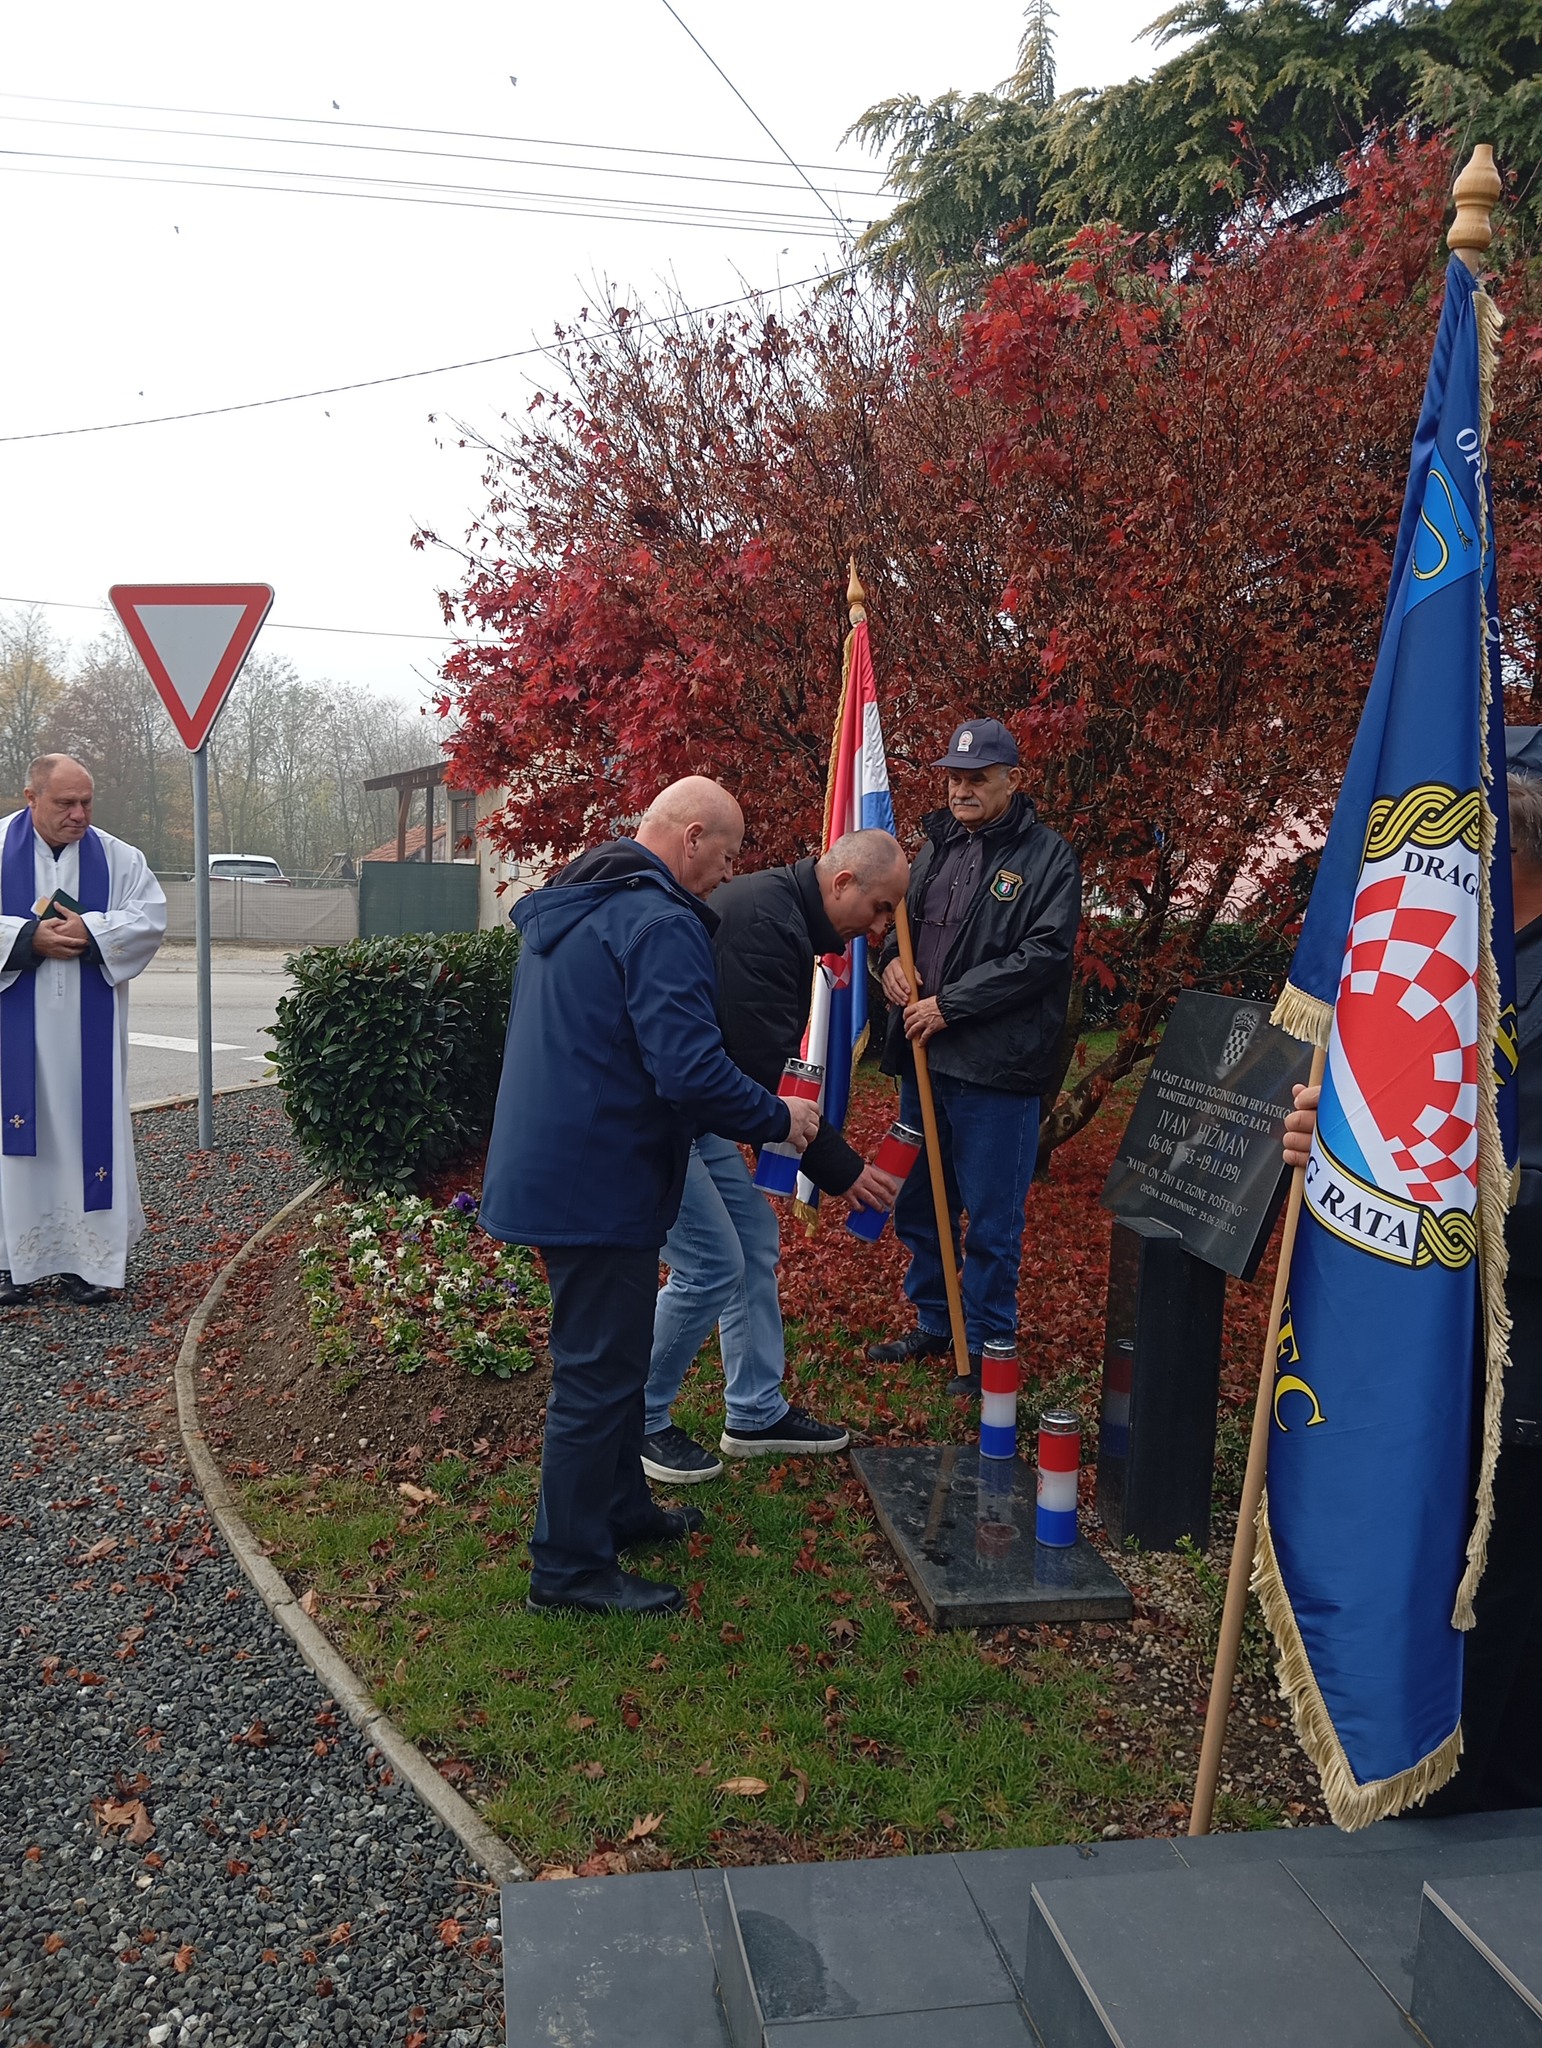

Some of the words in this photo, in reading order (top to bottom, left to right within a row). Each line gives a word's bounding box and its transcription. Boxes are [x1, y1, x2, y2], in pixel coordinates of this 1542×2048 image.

[1150, 1068, 1161, 1081] NA
[1161, 1070, 1180, 1086] ČAST
[1182, 1078, 1206, 1094] SLAVU
[1205, 1085, 1250, 1108] POGINULOM
[1248, 1097, 1293, 1120] HRVATSKO
[1157, 1086, 1196, 1108] BRANITELJU
[1194, 1099, 1250, 1126] DOMOVINSKOG
[1249, 1116, 1272, 1134] RATA
[1156, 1109, 1191, 1137] IVAN
[1196, 1122, 1250, 1159] HIŽMAN
[1148, 1166, 1161, 1180] ON
[1160, 1169, 1176, 1187] ŽIVI
[1184, 1182, 1208, 1202] ZGINE
[1317, 1180, 1409, 1250] RATA
